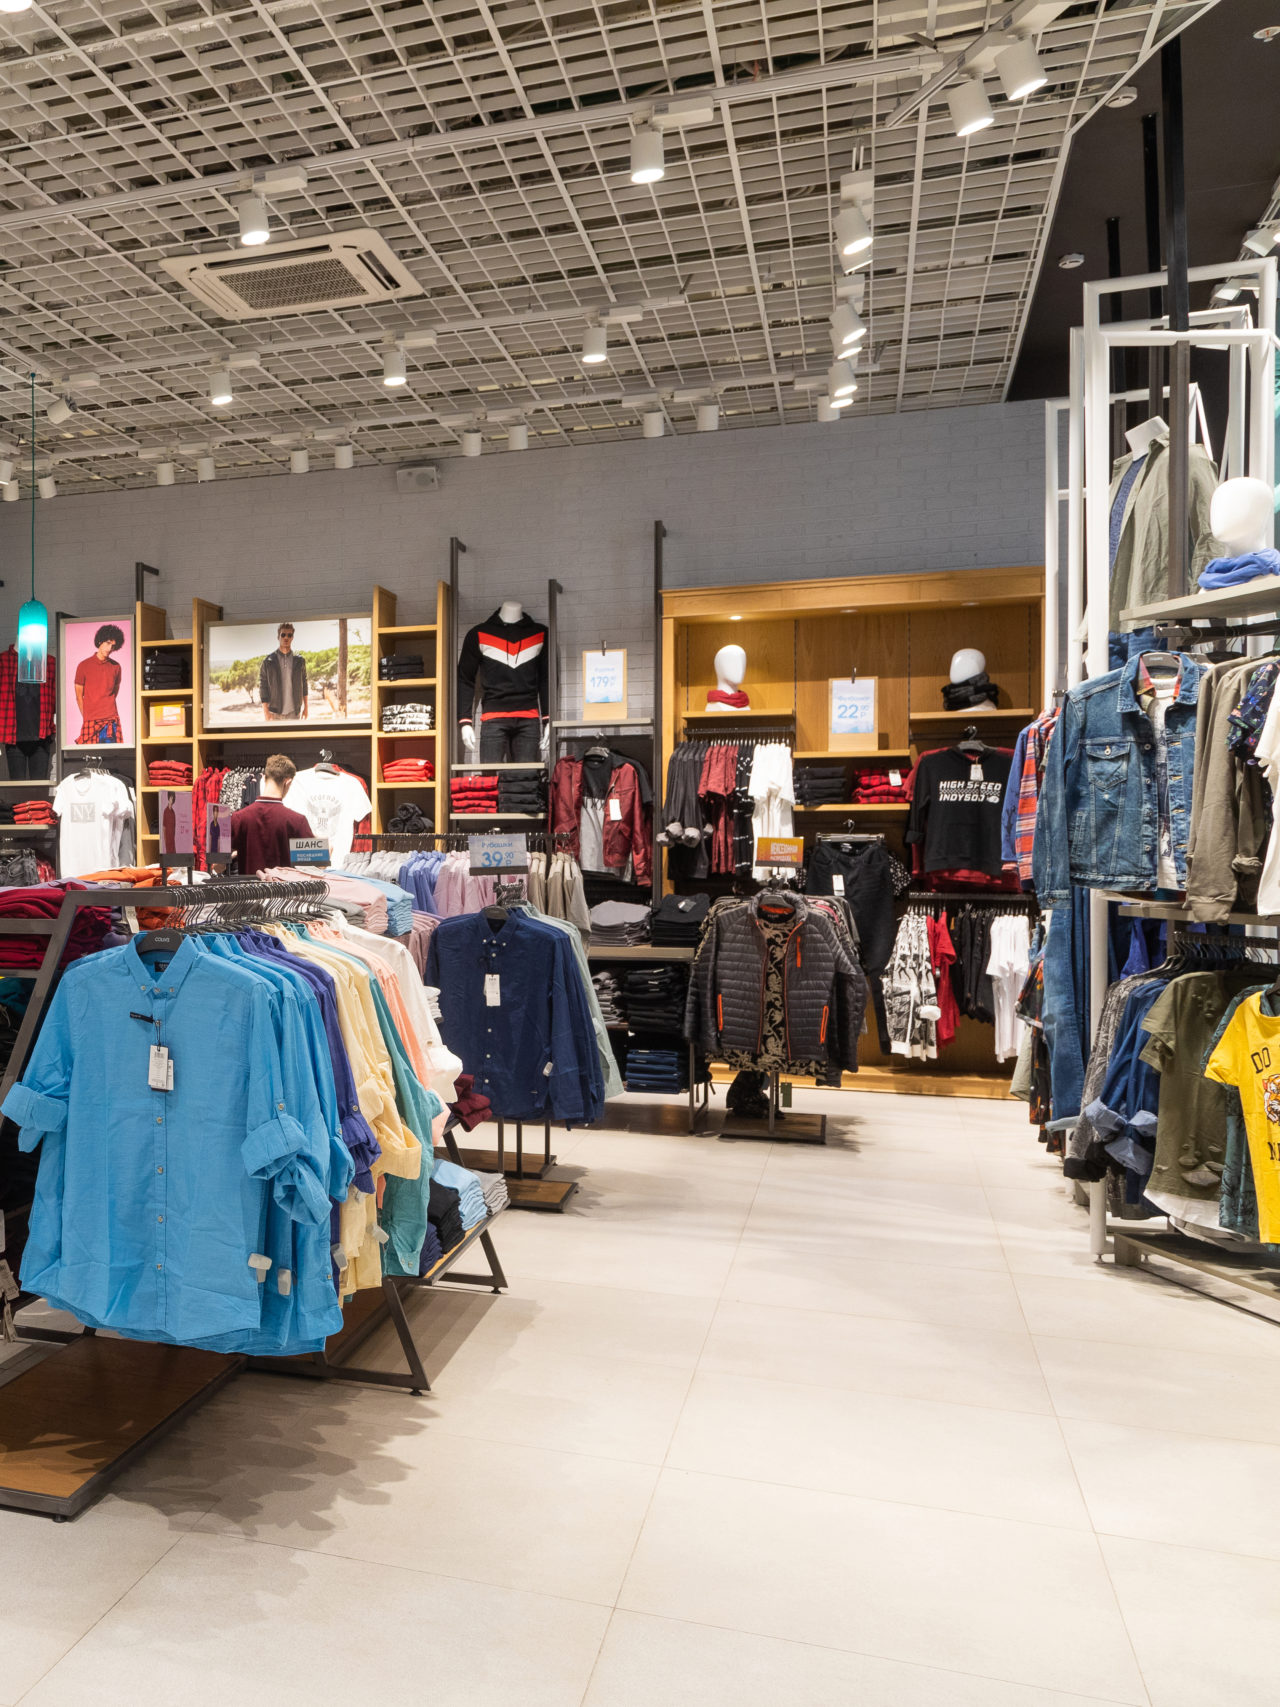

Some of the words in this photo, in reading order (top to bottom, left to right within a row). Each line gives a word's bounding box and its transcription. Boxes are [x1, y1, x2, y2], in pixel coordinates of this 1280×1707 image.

[837, 703, 858, 719] 22
[939, 780, 965, 789] HIGH
[295, 840, 323, 849] ШАНС
[481, 851, 503, 868] 39
[1250, 1046, 1272, 1074] DO
